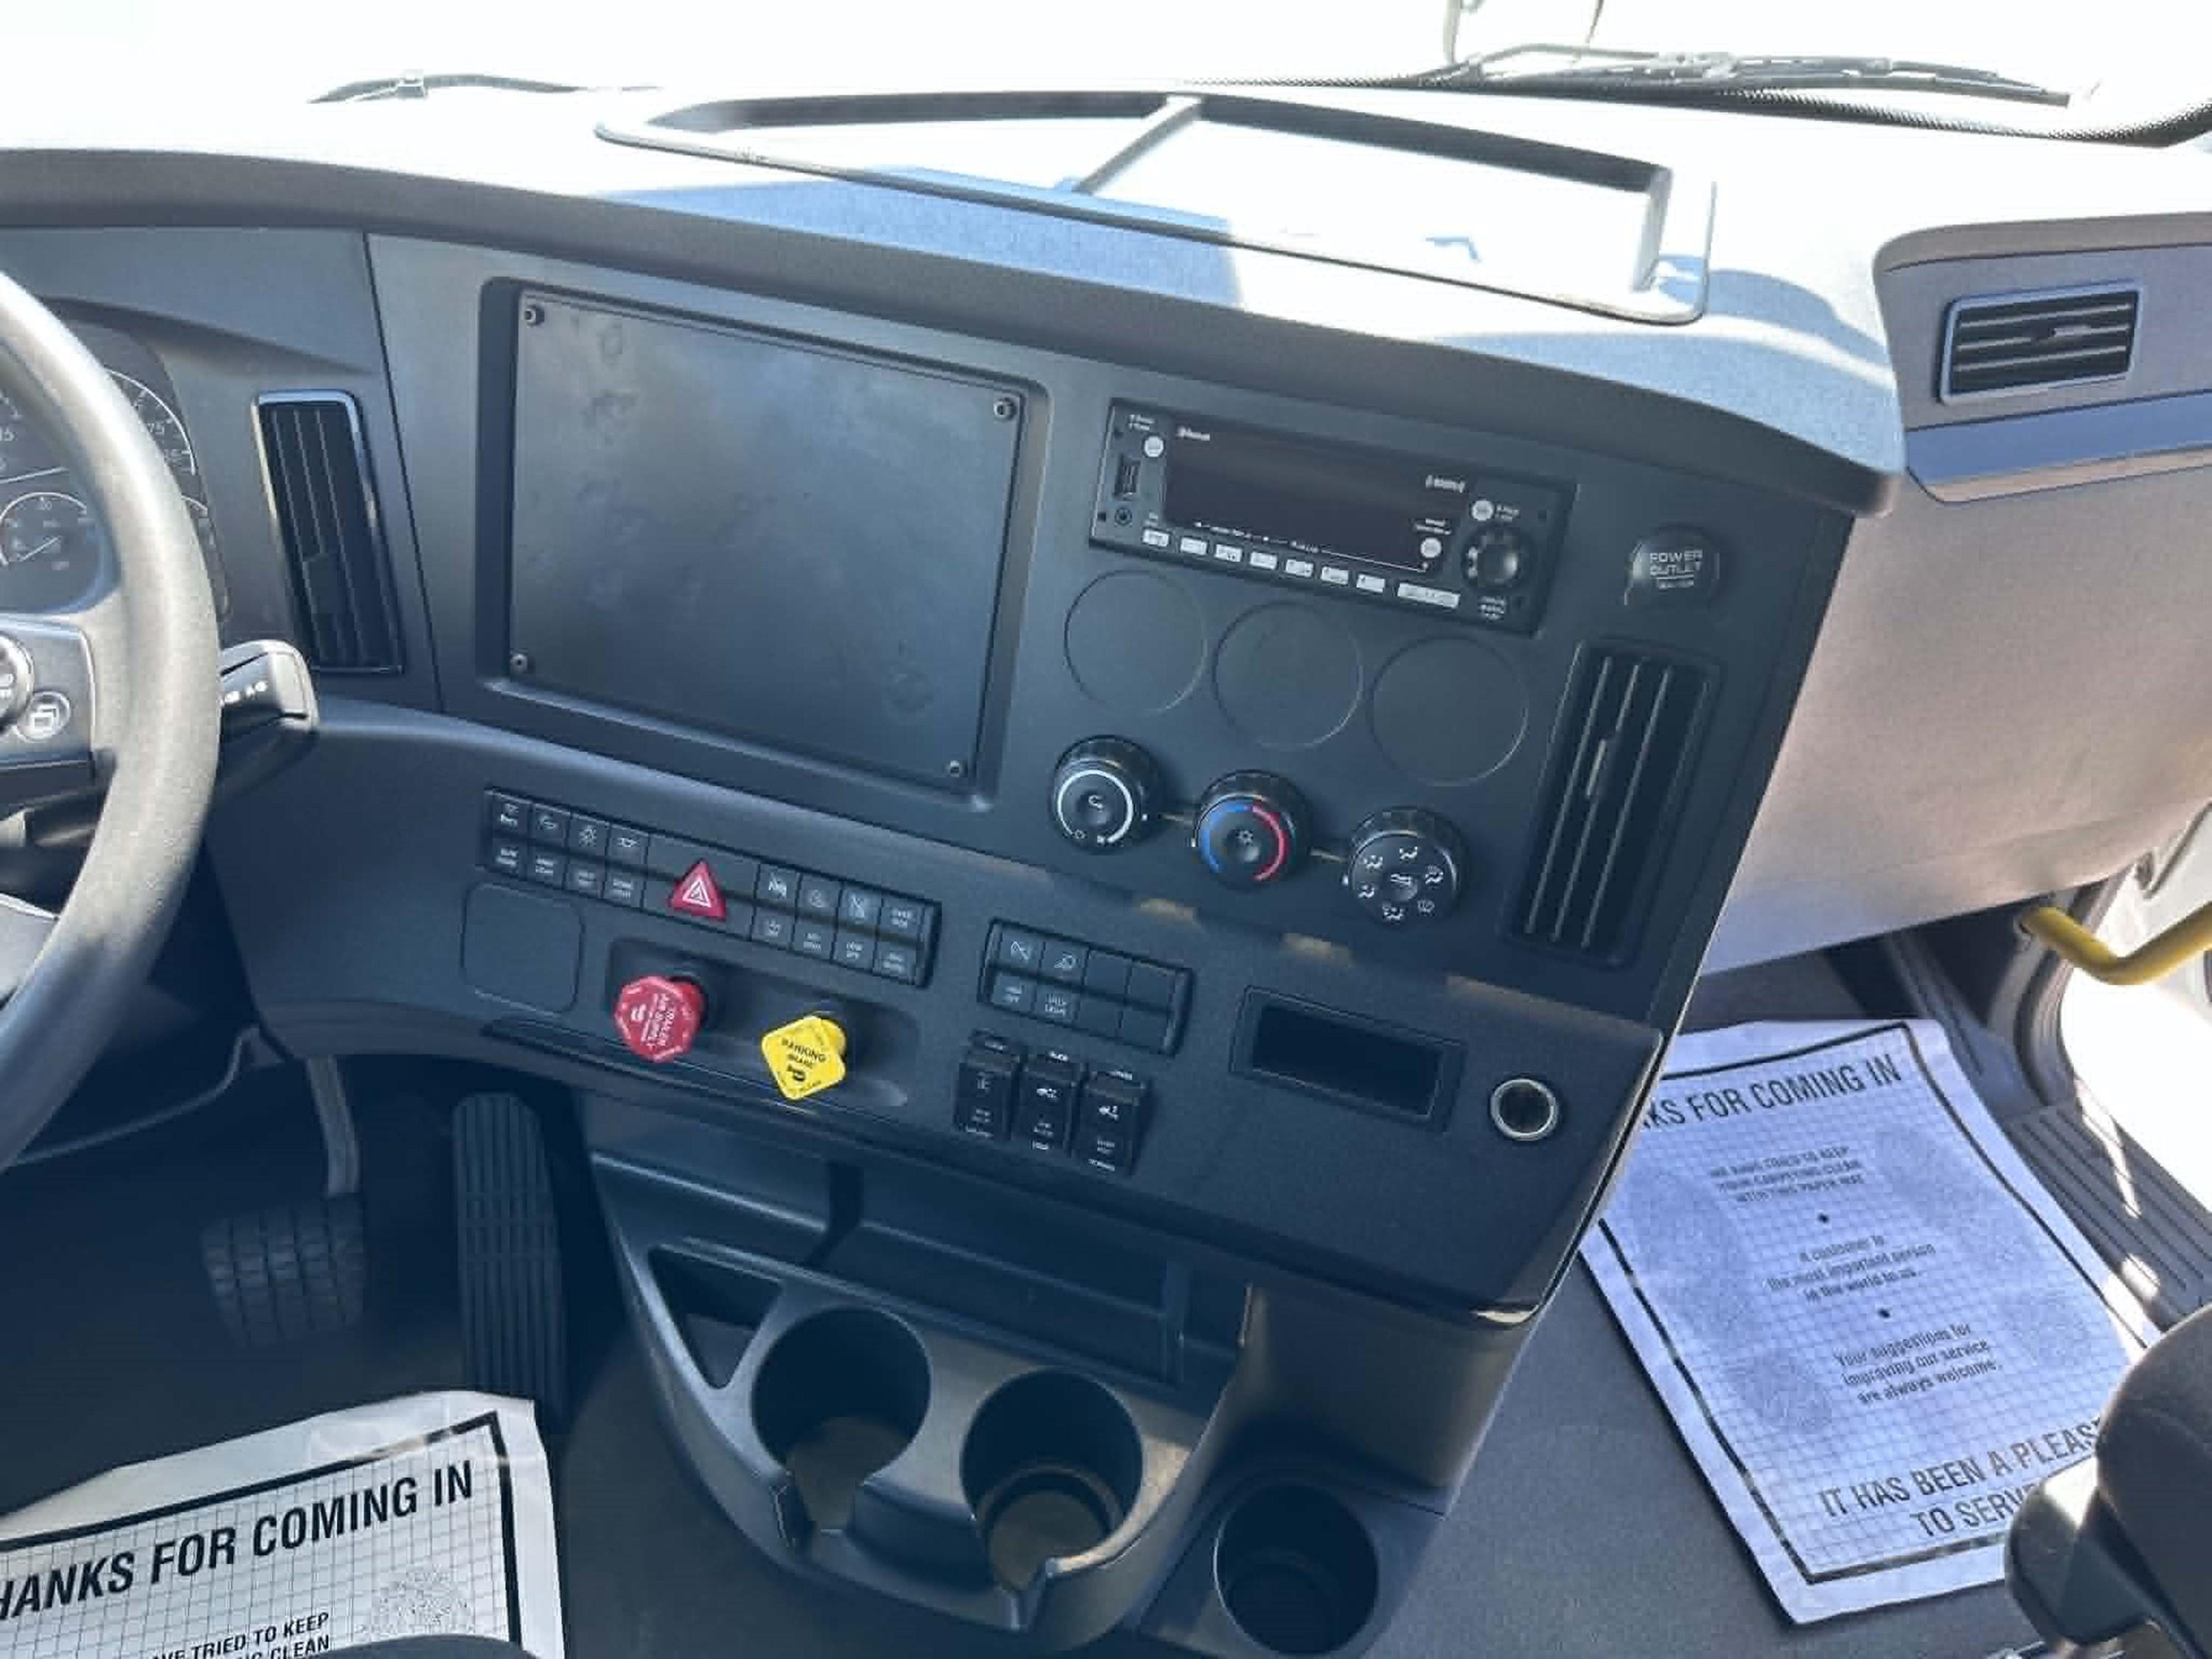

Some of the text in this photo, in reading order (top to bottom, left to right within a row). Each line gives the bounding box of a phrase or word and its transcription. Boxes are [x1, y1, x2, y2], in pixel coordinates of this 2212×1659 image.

[1649, 549, 1703, 563] POWER
[1686, 1088, 1751, 1121] FOR
[1750, 1065, 1866, 1109] COMING
[1865, 1053, 1902, 1087] IN
[1818, 1415, 2101, 1517] IT HAS BEEN A PLEAS
[150, 1526, 237, 1585] FOR
[253, 1476, 418, 1557] COMING
[434, 1459, 473, 1507] IN
[1913, 1507, 1956, 1537] TO
[191, 1634, 246, 1659] TRIED
[254, 1625, 276, 1646] TO
[282, 1611, 330, 1638] KEEP
[270, 1634, 330, 1659] CLEAN
